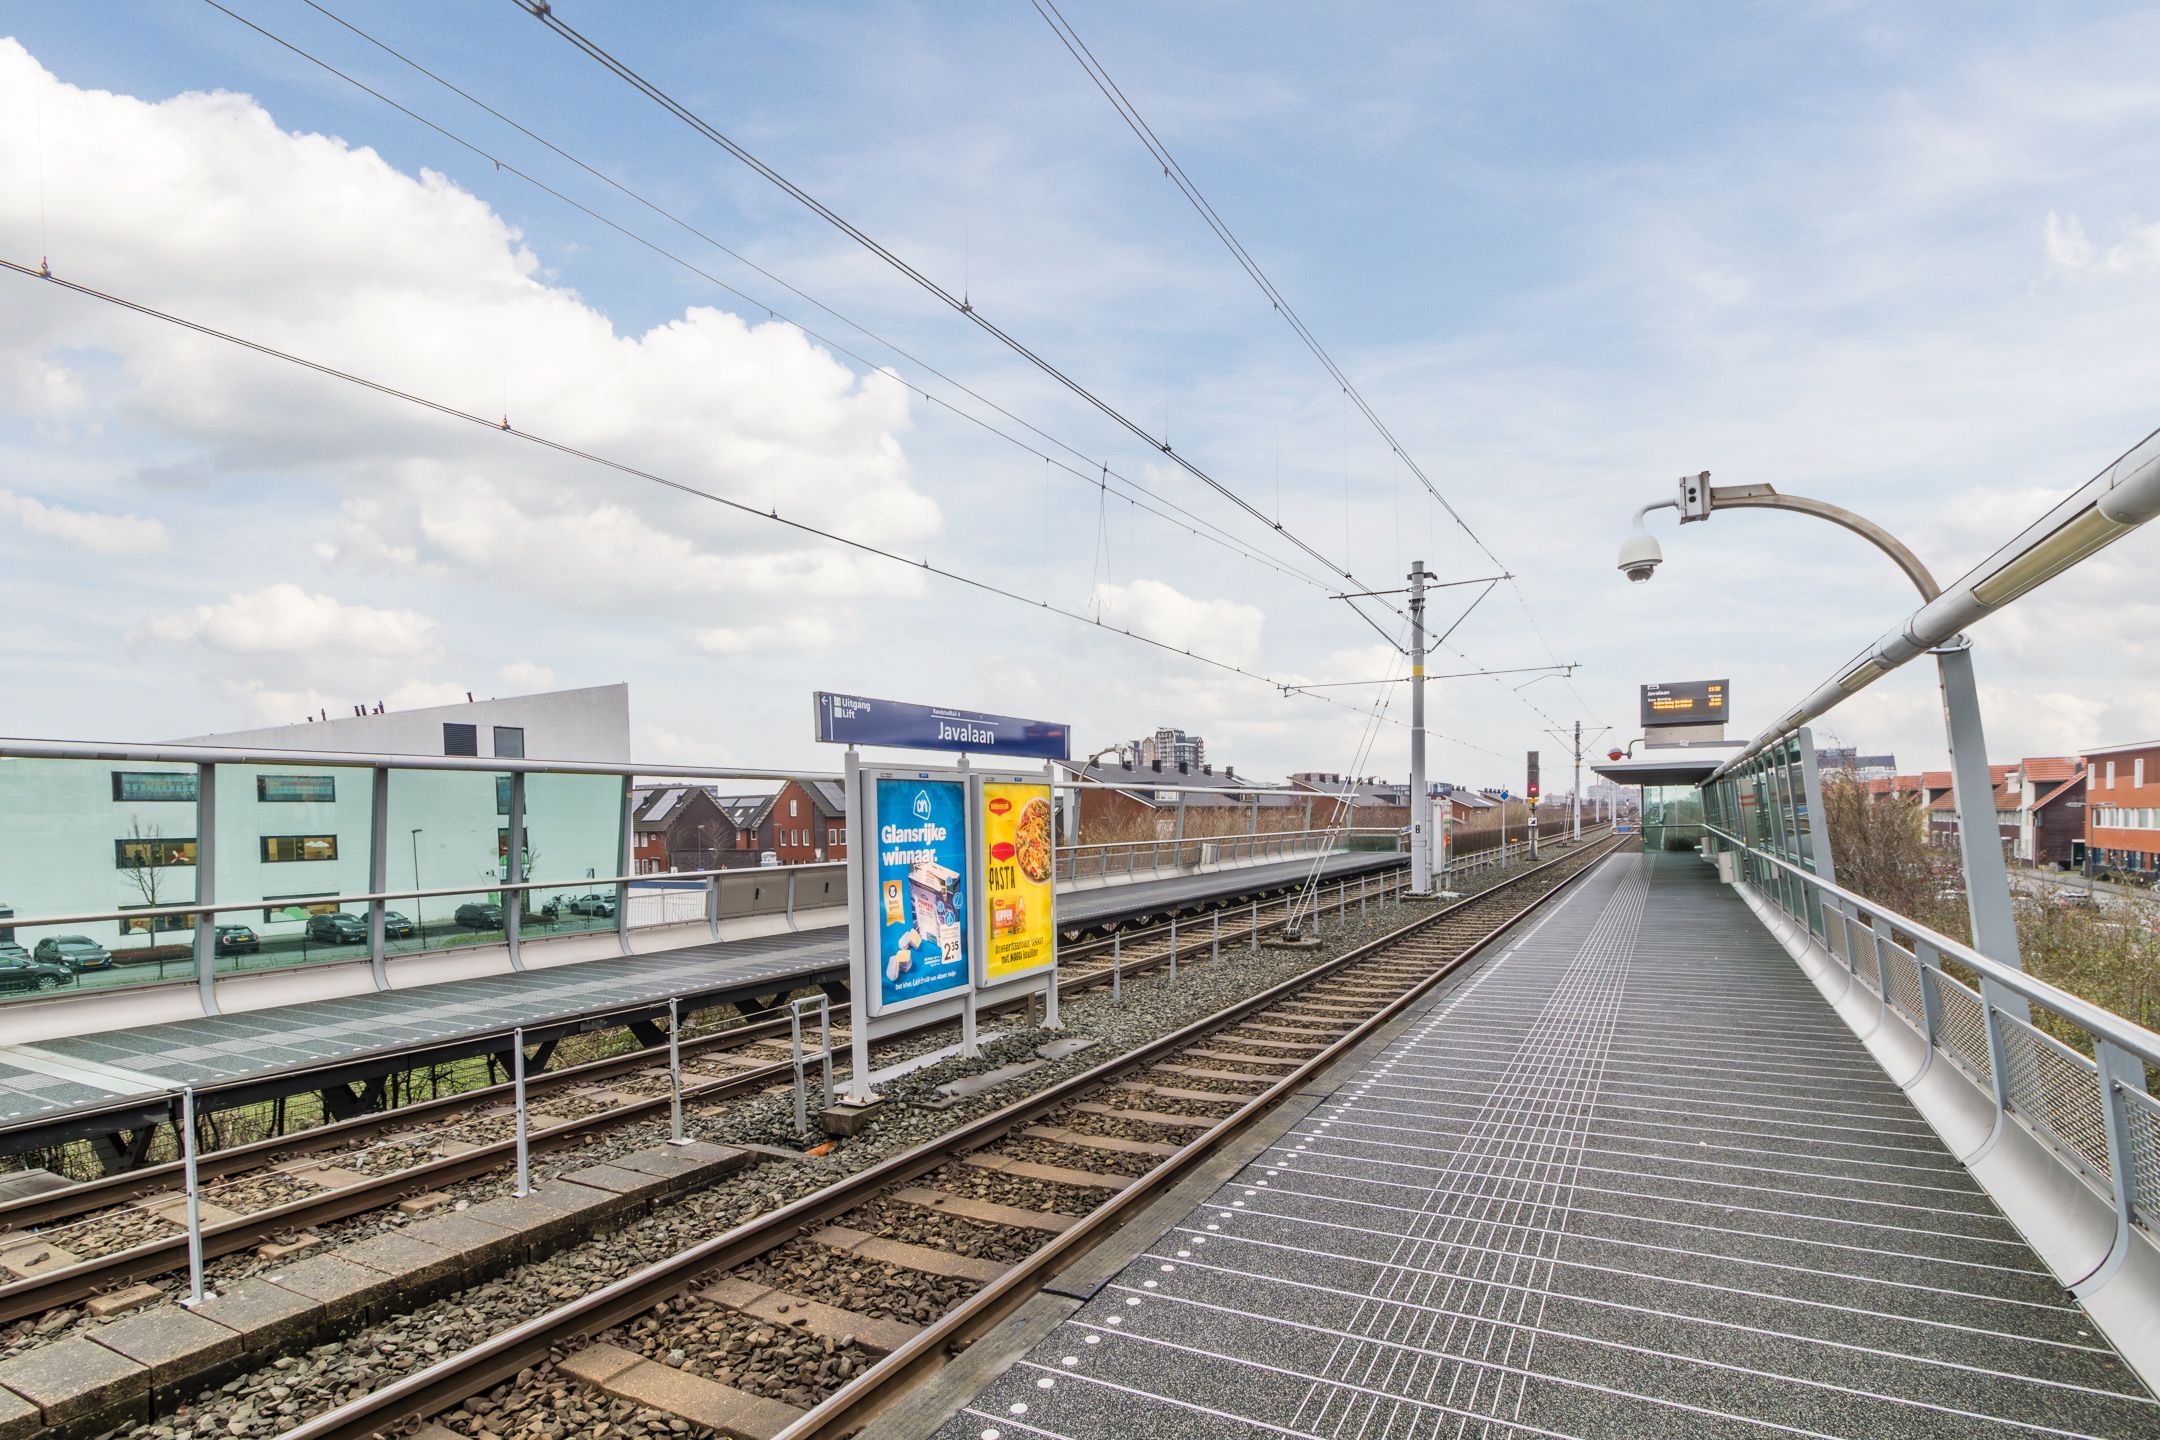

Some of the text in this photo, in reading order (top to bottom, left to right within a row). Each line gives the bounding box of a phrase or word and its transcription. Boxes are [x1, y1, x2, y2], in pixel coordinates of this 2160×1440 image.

[842, 698, 871, 712] Uitgang
[842, 708, 856, 719] Lift
[938, 721, 995, 745] Javalaan
[881, 823, 947, 846] Glansrijke
[882, 846, 938, 866] winnaar.
[989, 865, 1016, 891] PASTA
